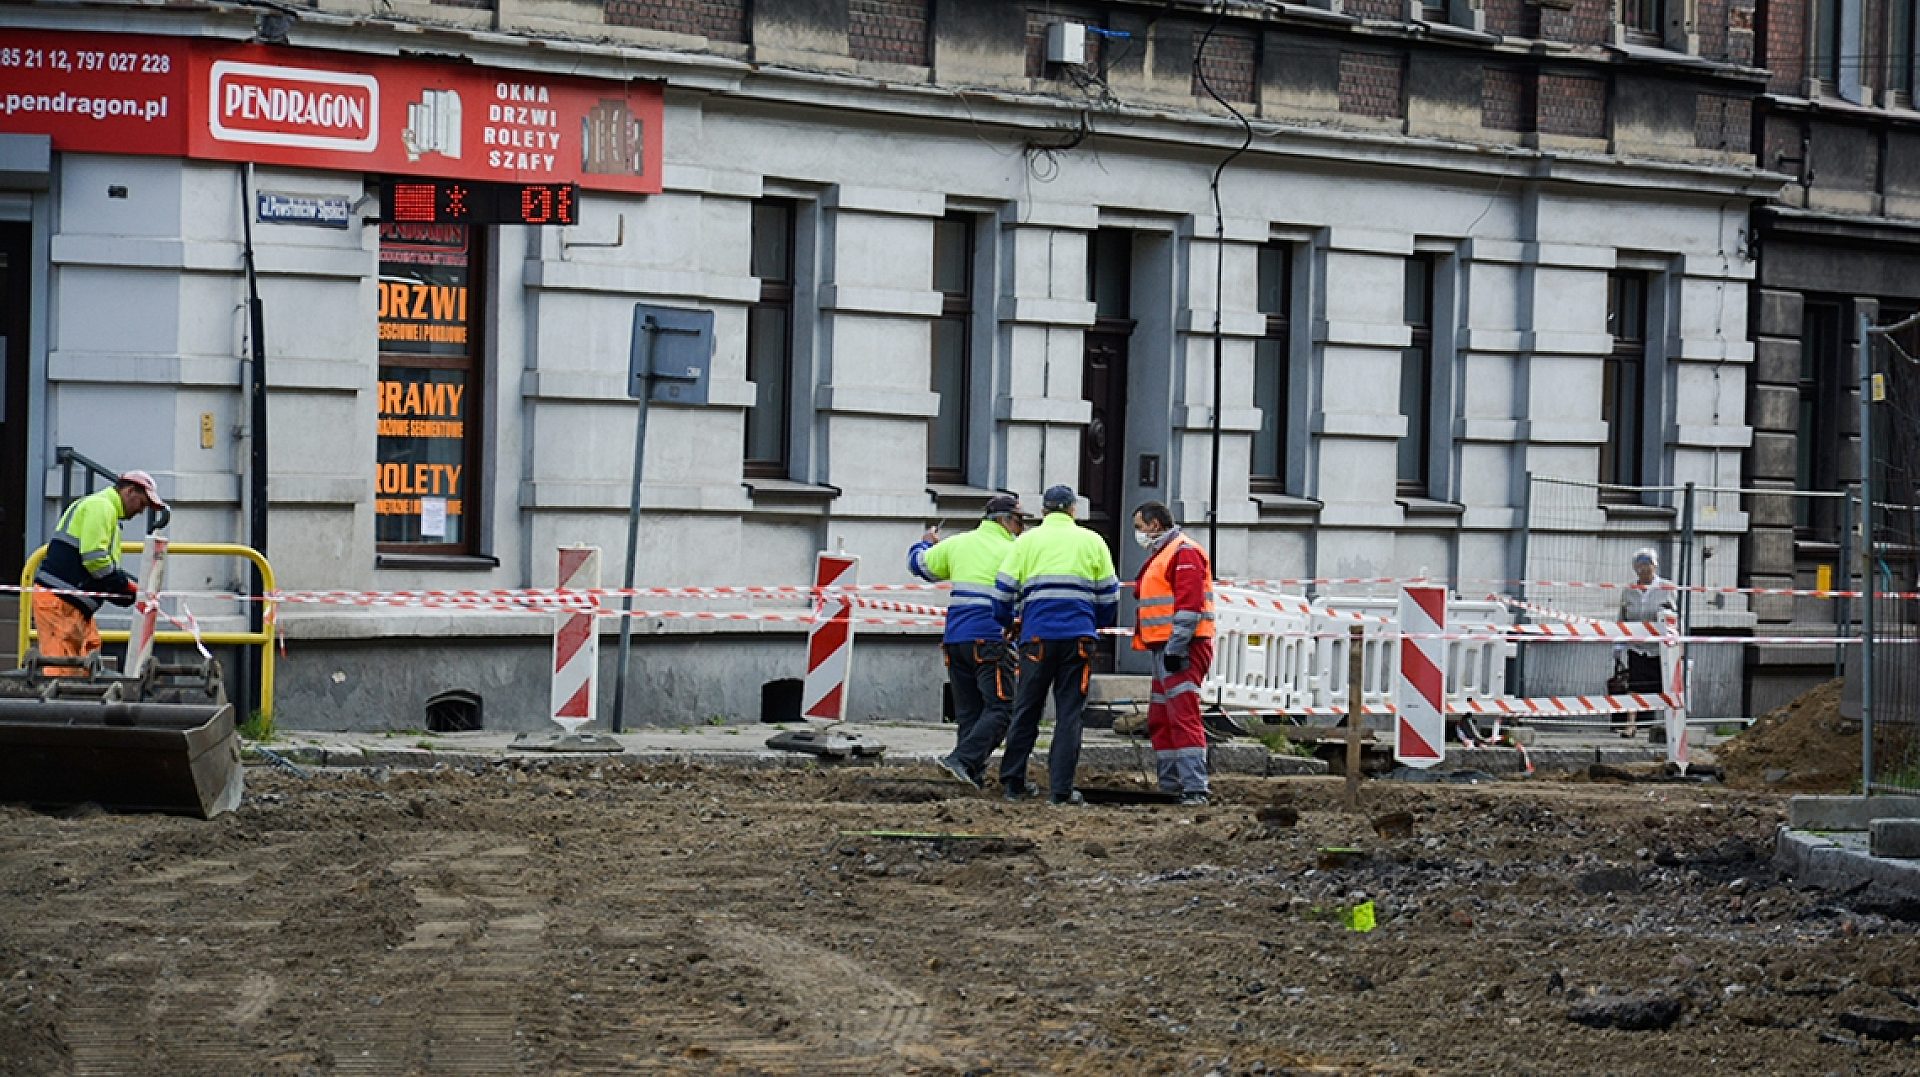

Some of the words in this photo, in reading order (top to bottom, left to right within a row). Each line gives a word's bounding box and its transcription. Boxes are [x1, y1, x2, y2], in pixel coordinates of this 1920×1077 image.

[0, 47, 21, 67] 85
[24, 48, 43, 68] 21
[48, 49, 72, 73] 12,
[76, 51, 105, 71] 797
[108, 52, 138, 72] 027
[141, 53, 171, 74] 228
[496, 82, 549, 104] OKNA
[225, 83, 364, 129] PENDRAGON
[488, 104, 558, 127] DRZWI
[484, 126, 561, 150] ROLETY
[488, 150, 555, 172] SZAFY
